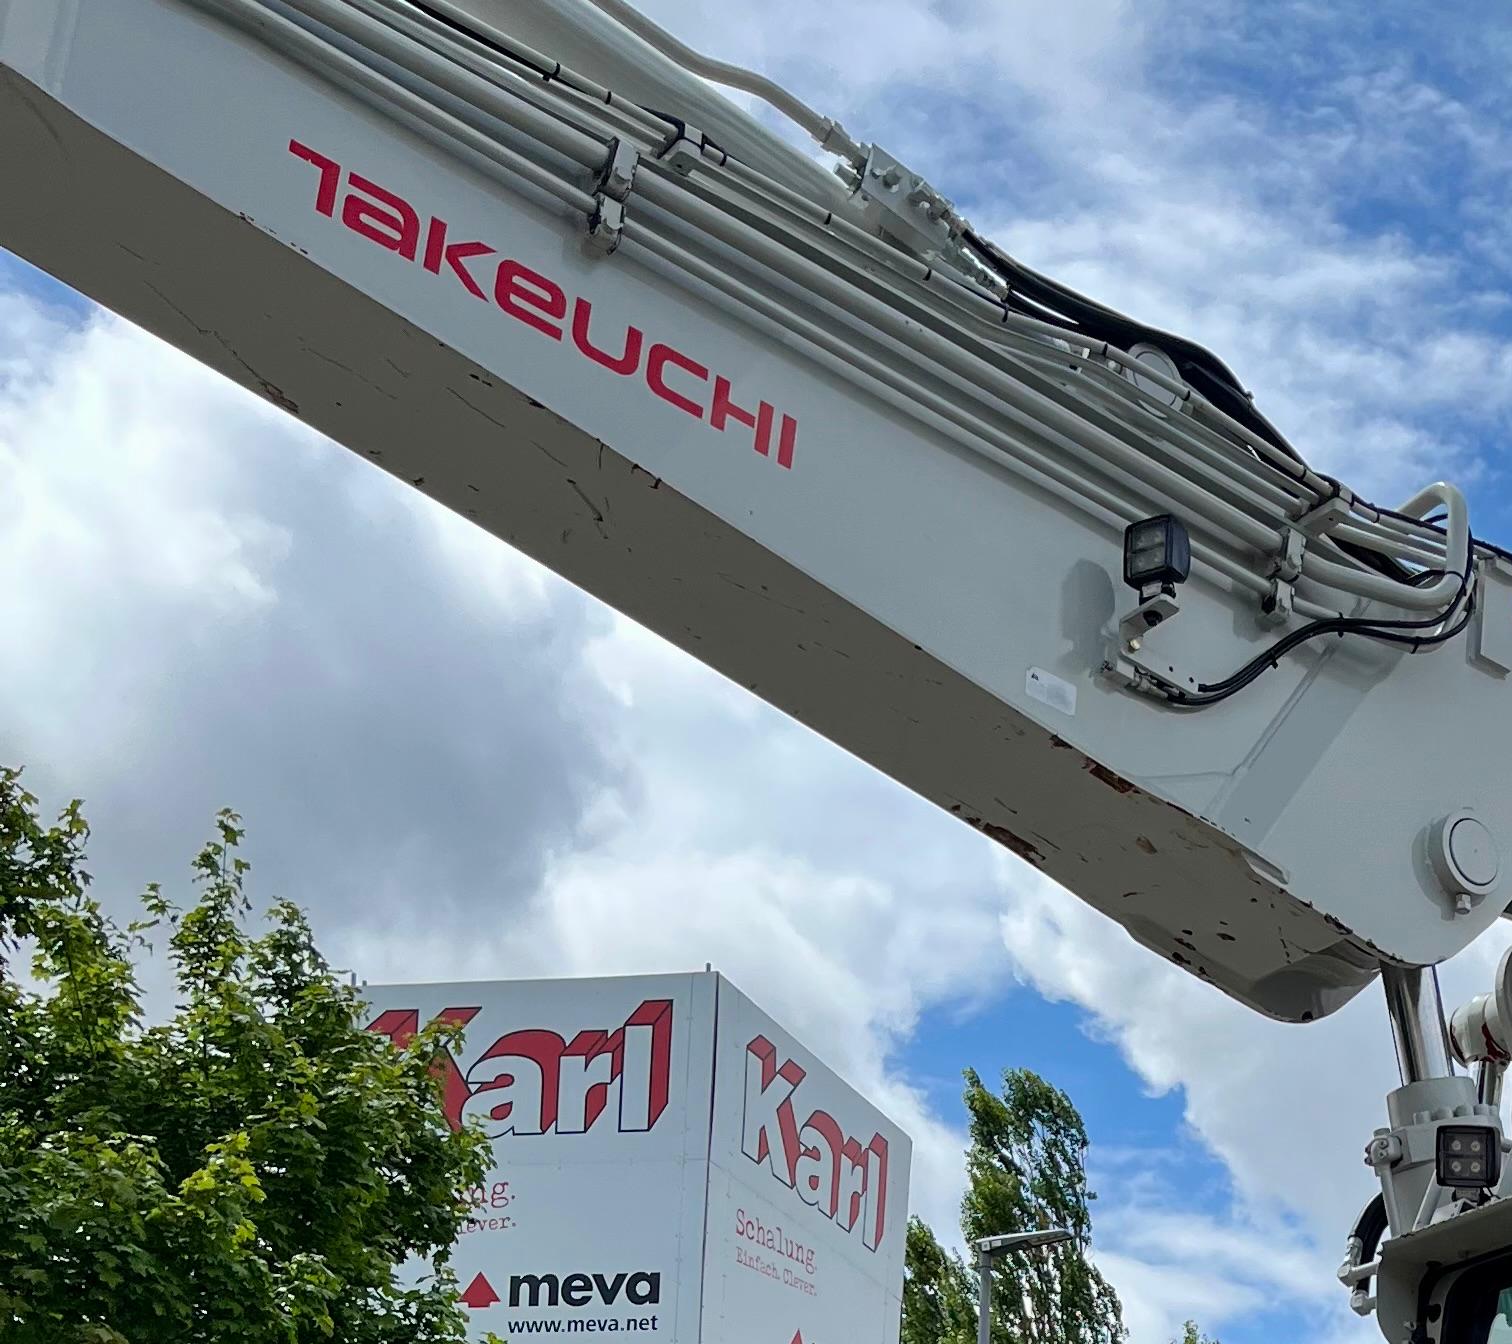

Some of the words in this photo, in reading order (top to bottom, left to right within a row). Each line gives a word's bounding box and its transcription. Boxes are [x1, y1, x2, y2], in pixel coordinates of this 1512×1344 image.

[741, 1034, 888, 1253] Karl
[508, 1271, 661, 1308] meva
[507, 1314, 659, 1334] www.meva.net
